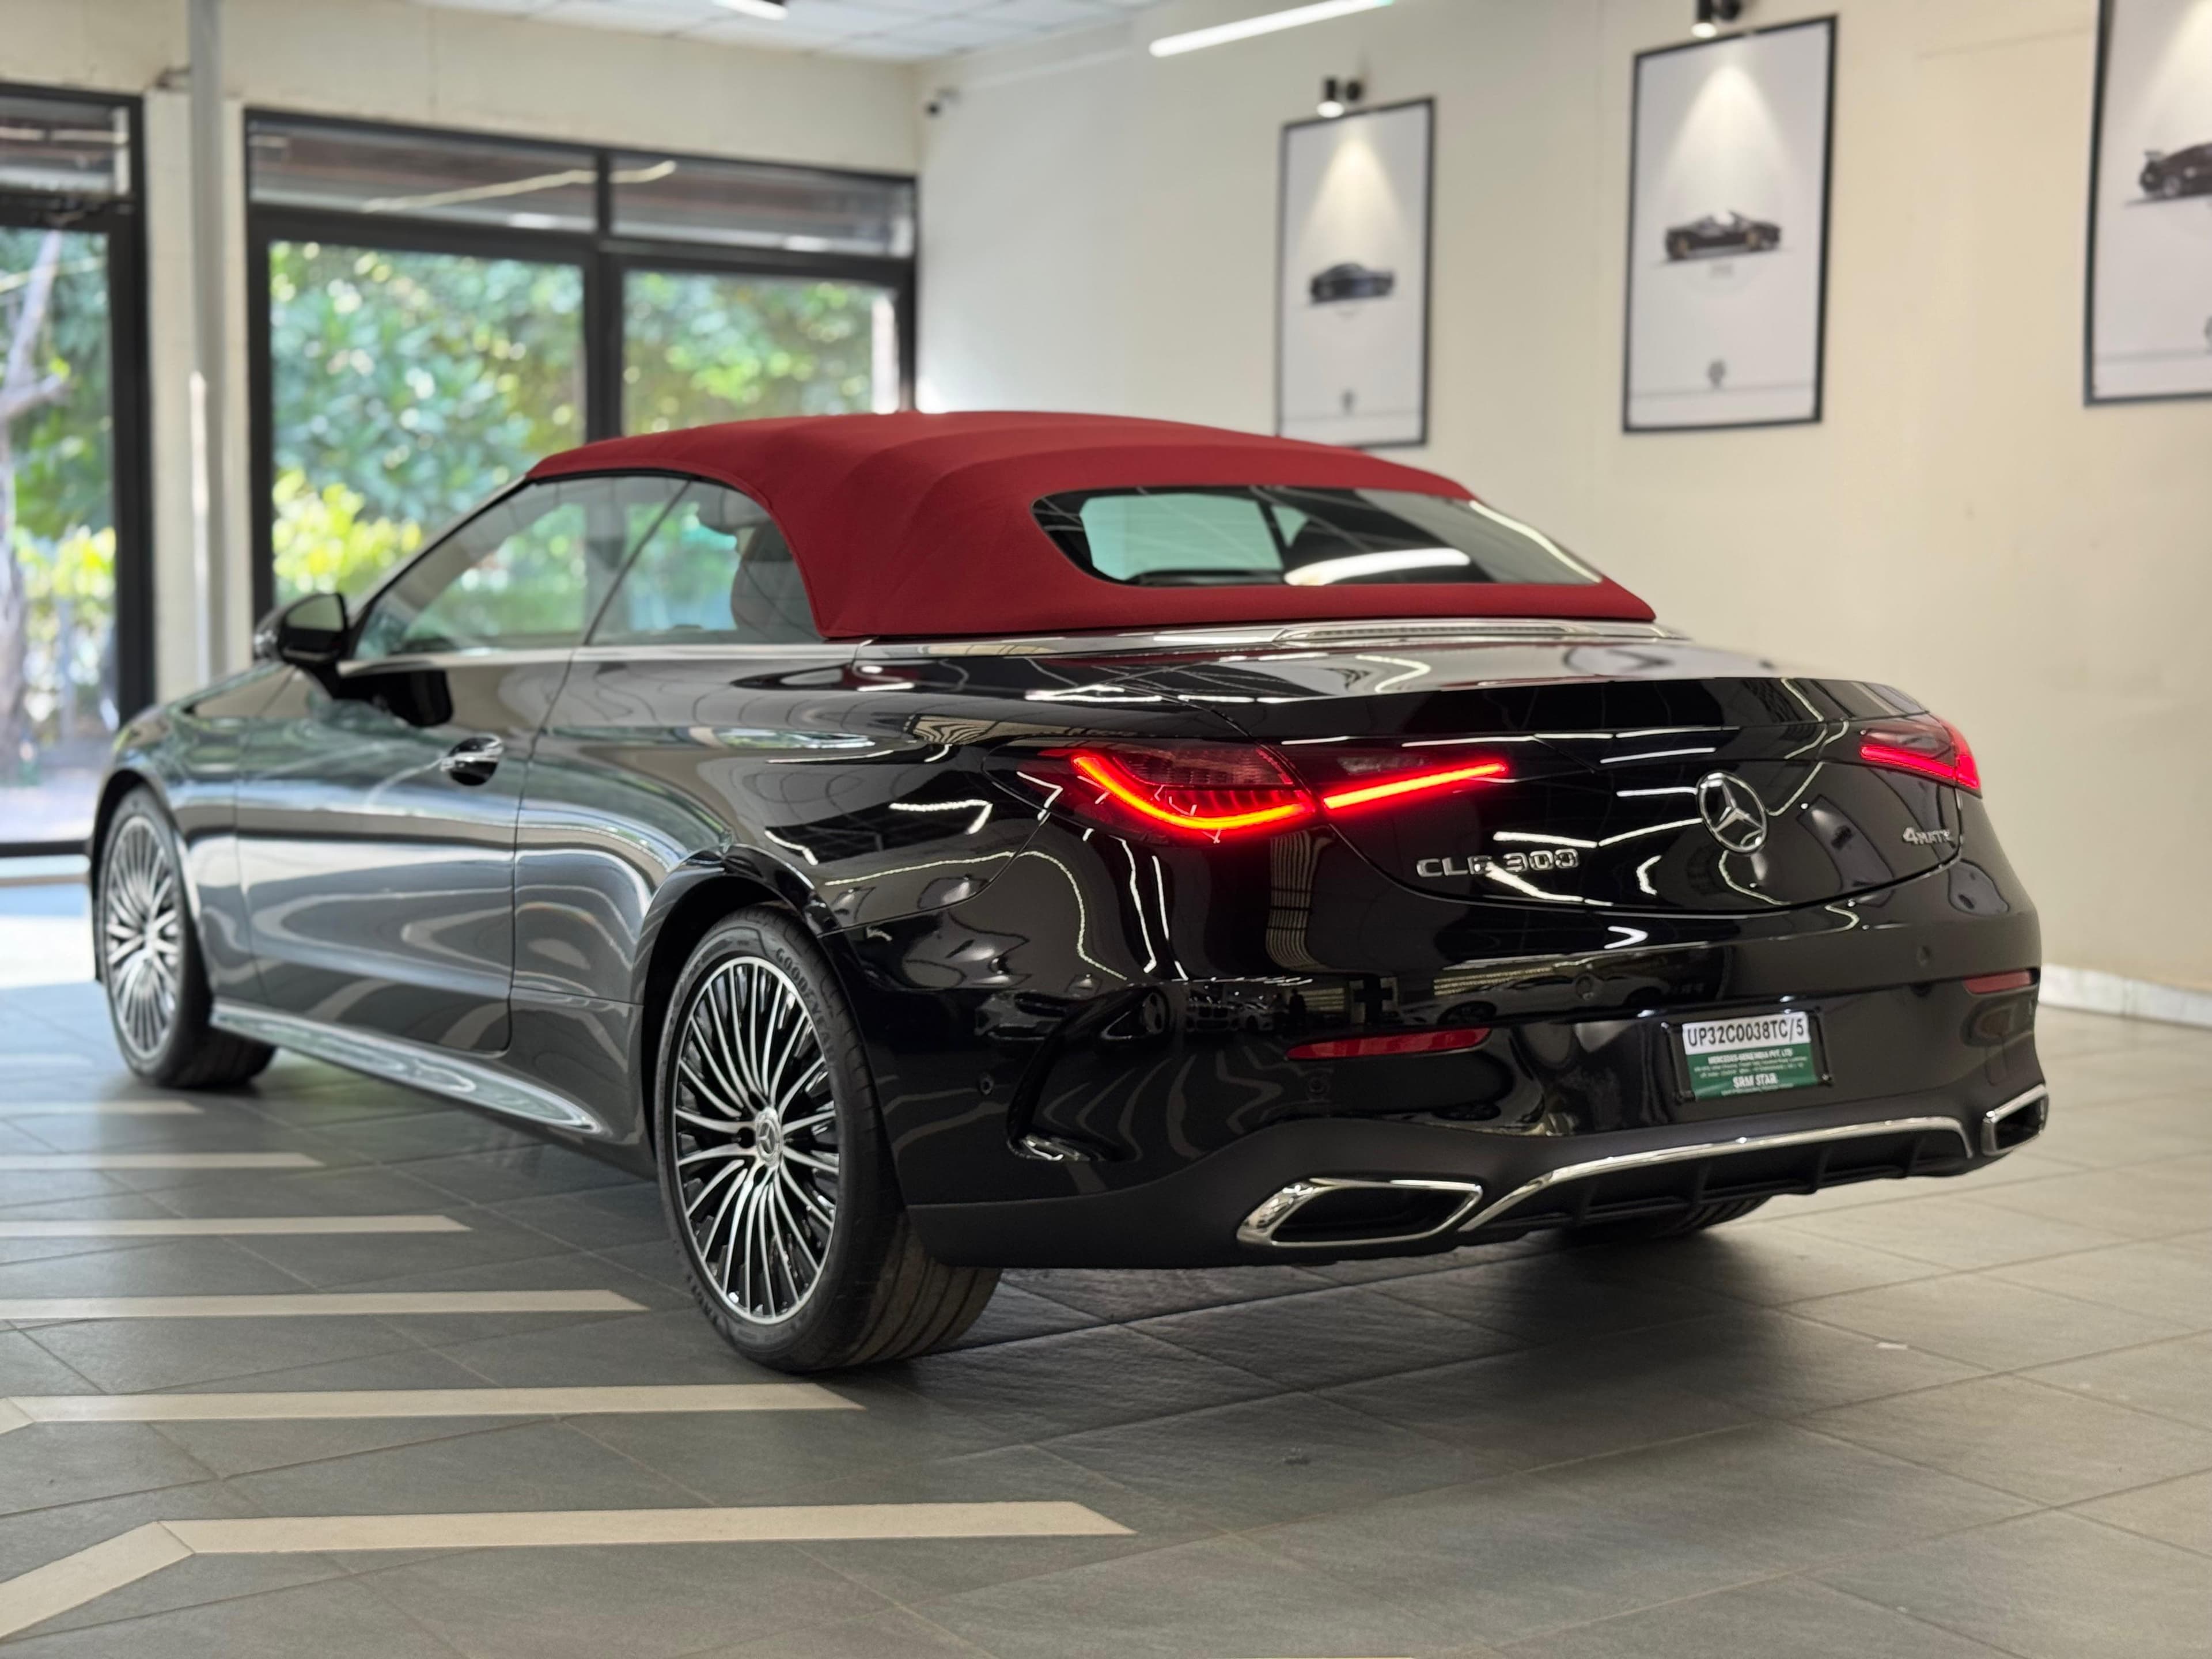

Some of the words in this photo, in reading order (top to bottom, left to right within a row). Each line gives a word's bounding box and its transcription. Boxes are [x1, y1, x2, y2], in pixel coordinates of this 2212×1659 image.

[1503, 849, 1579, 872] 300
[1733, 1075, 1753, 1088] SRM
[1755, 1073, 1778, 1086] STAR
